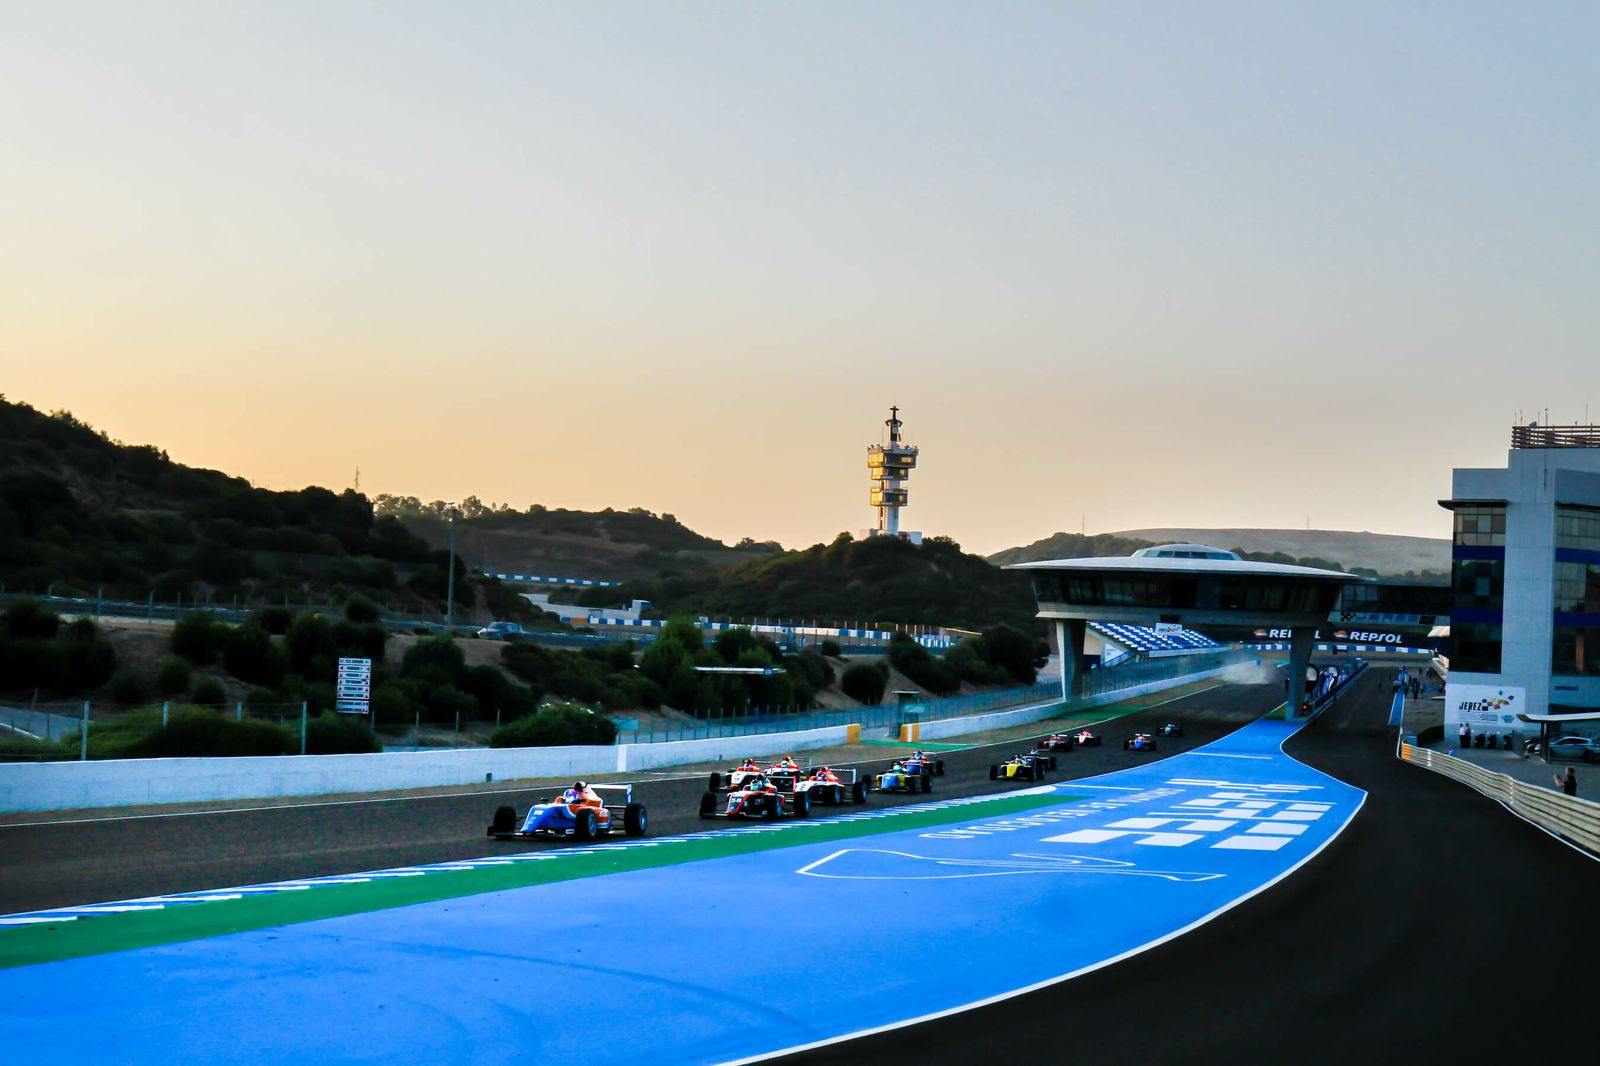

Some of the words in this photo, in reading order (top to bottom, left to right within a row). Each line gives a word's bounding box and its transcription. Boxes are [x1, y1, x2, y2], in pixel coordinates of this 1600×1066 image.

[1269, 629, 1321, 639] REL
[1350, 631, 1402, 644] REPSOL
[1459, 701, 1482, 712] JEREZ
